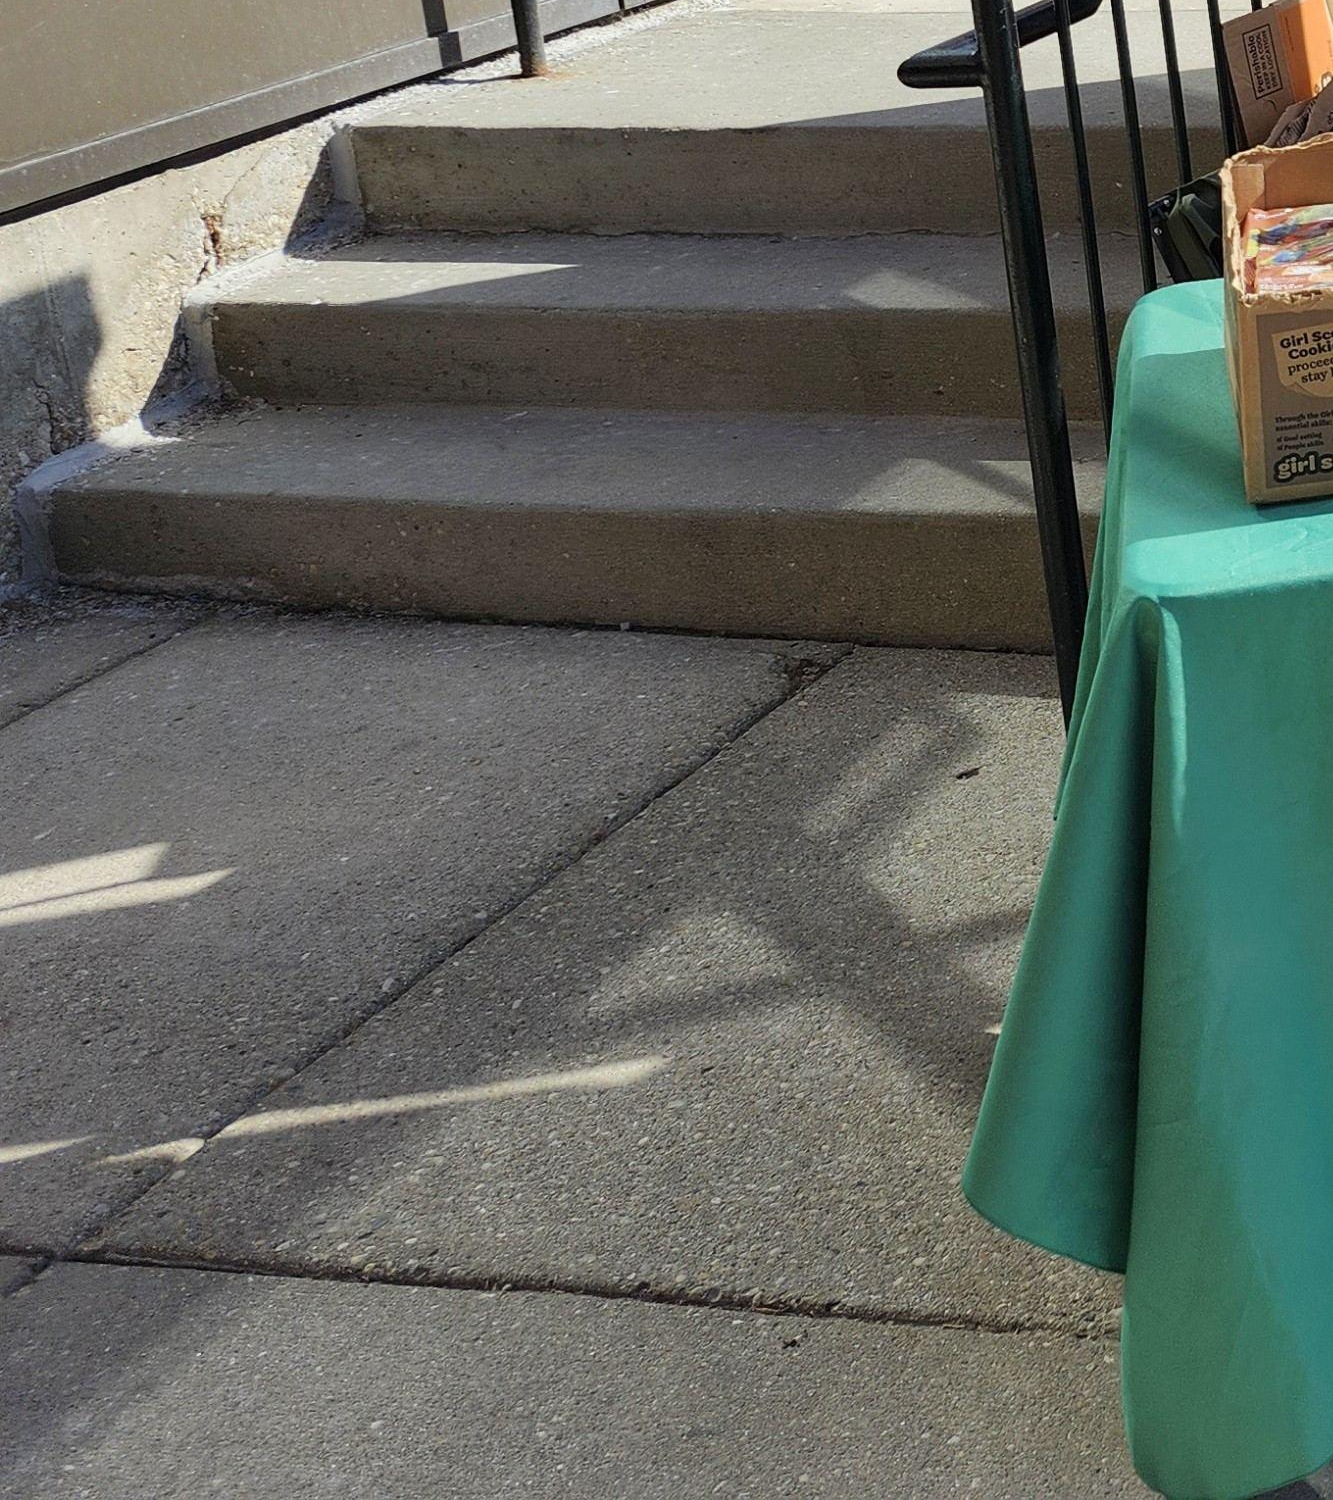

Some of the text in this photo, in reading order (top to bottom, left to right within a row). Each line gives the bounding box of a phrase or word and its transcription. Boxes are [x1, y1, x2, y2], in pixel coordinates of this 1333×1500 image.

[1248, 35, 1264, 93] Perishable
[1280, 332, 1309, 349] Girl
[1301, 370, 1328, 383] stay
[1278, 454, 1316, 479] girl
